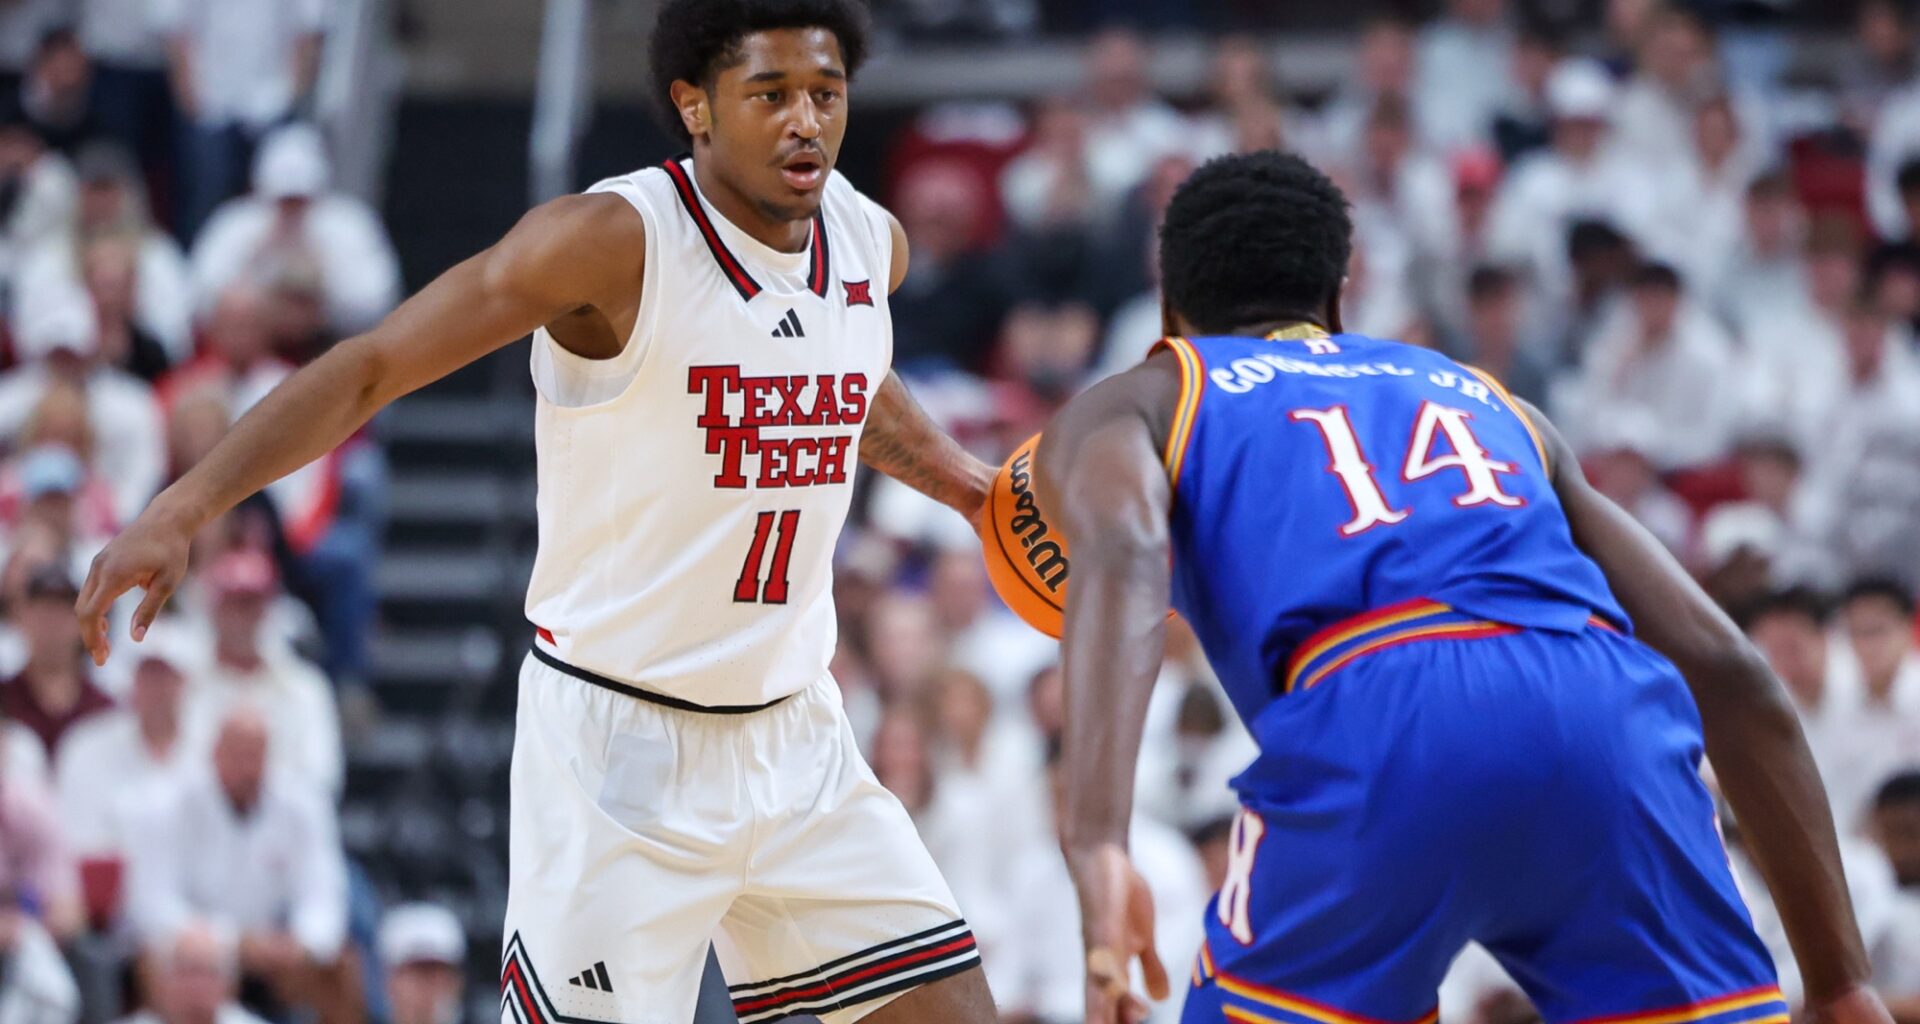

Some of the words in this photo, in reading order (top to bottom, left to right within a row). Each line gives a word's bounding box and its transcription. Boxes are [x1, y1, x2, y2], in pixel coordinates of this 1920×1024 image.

[687, 365, 868, 428] TEXAS
[705, 427, 852, 489] TECH
[1287, 399, 1527, 539] 14
[733, 509, 802, 604] 11
[1011, 449, 1070, 593] Wilson
